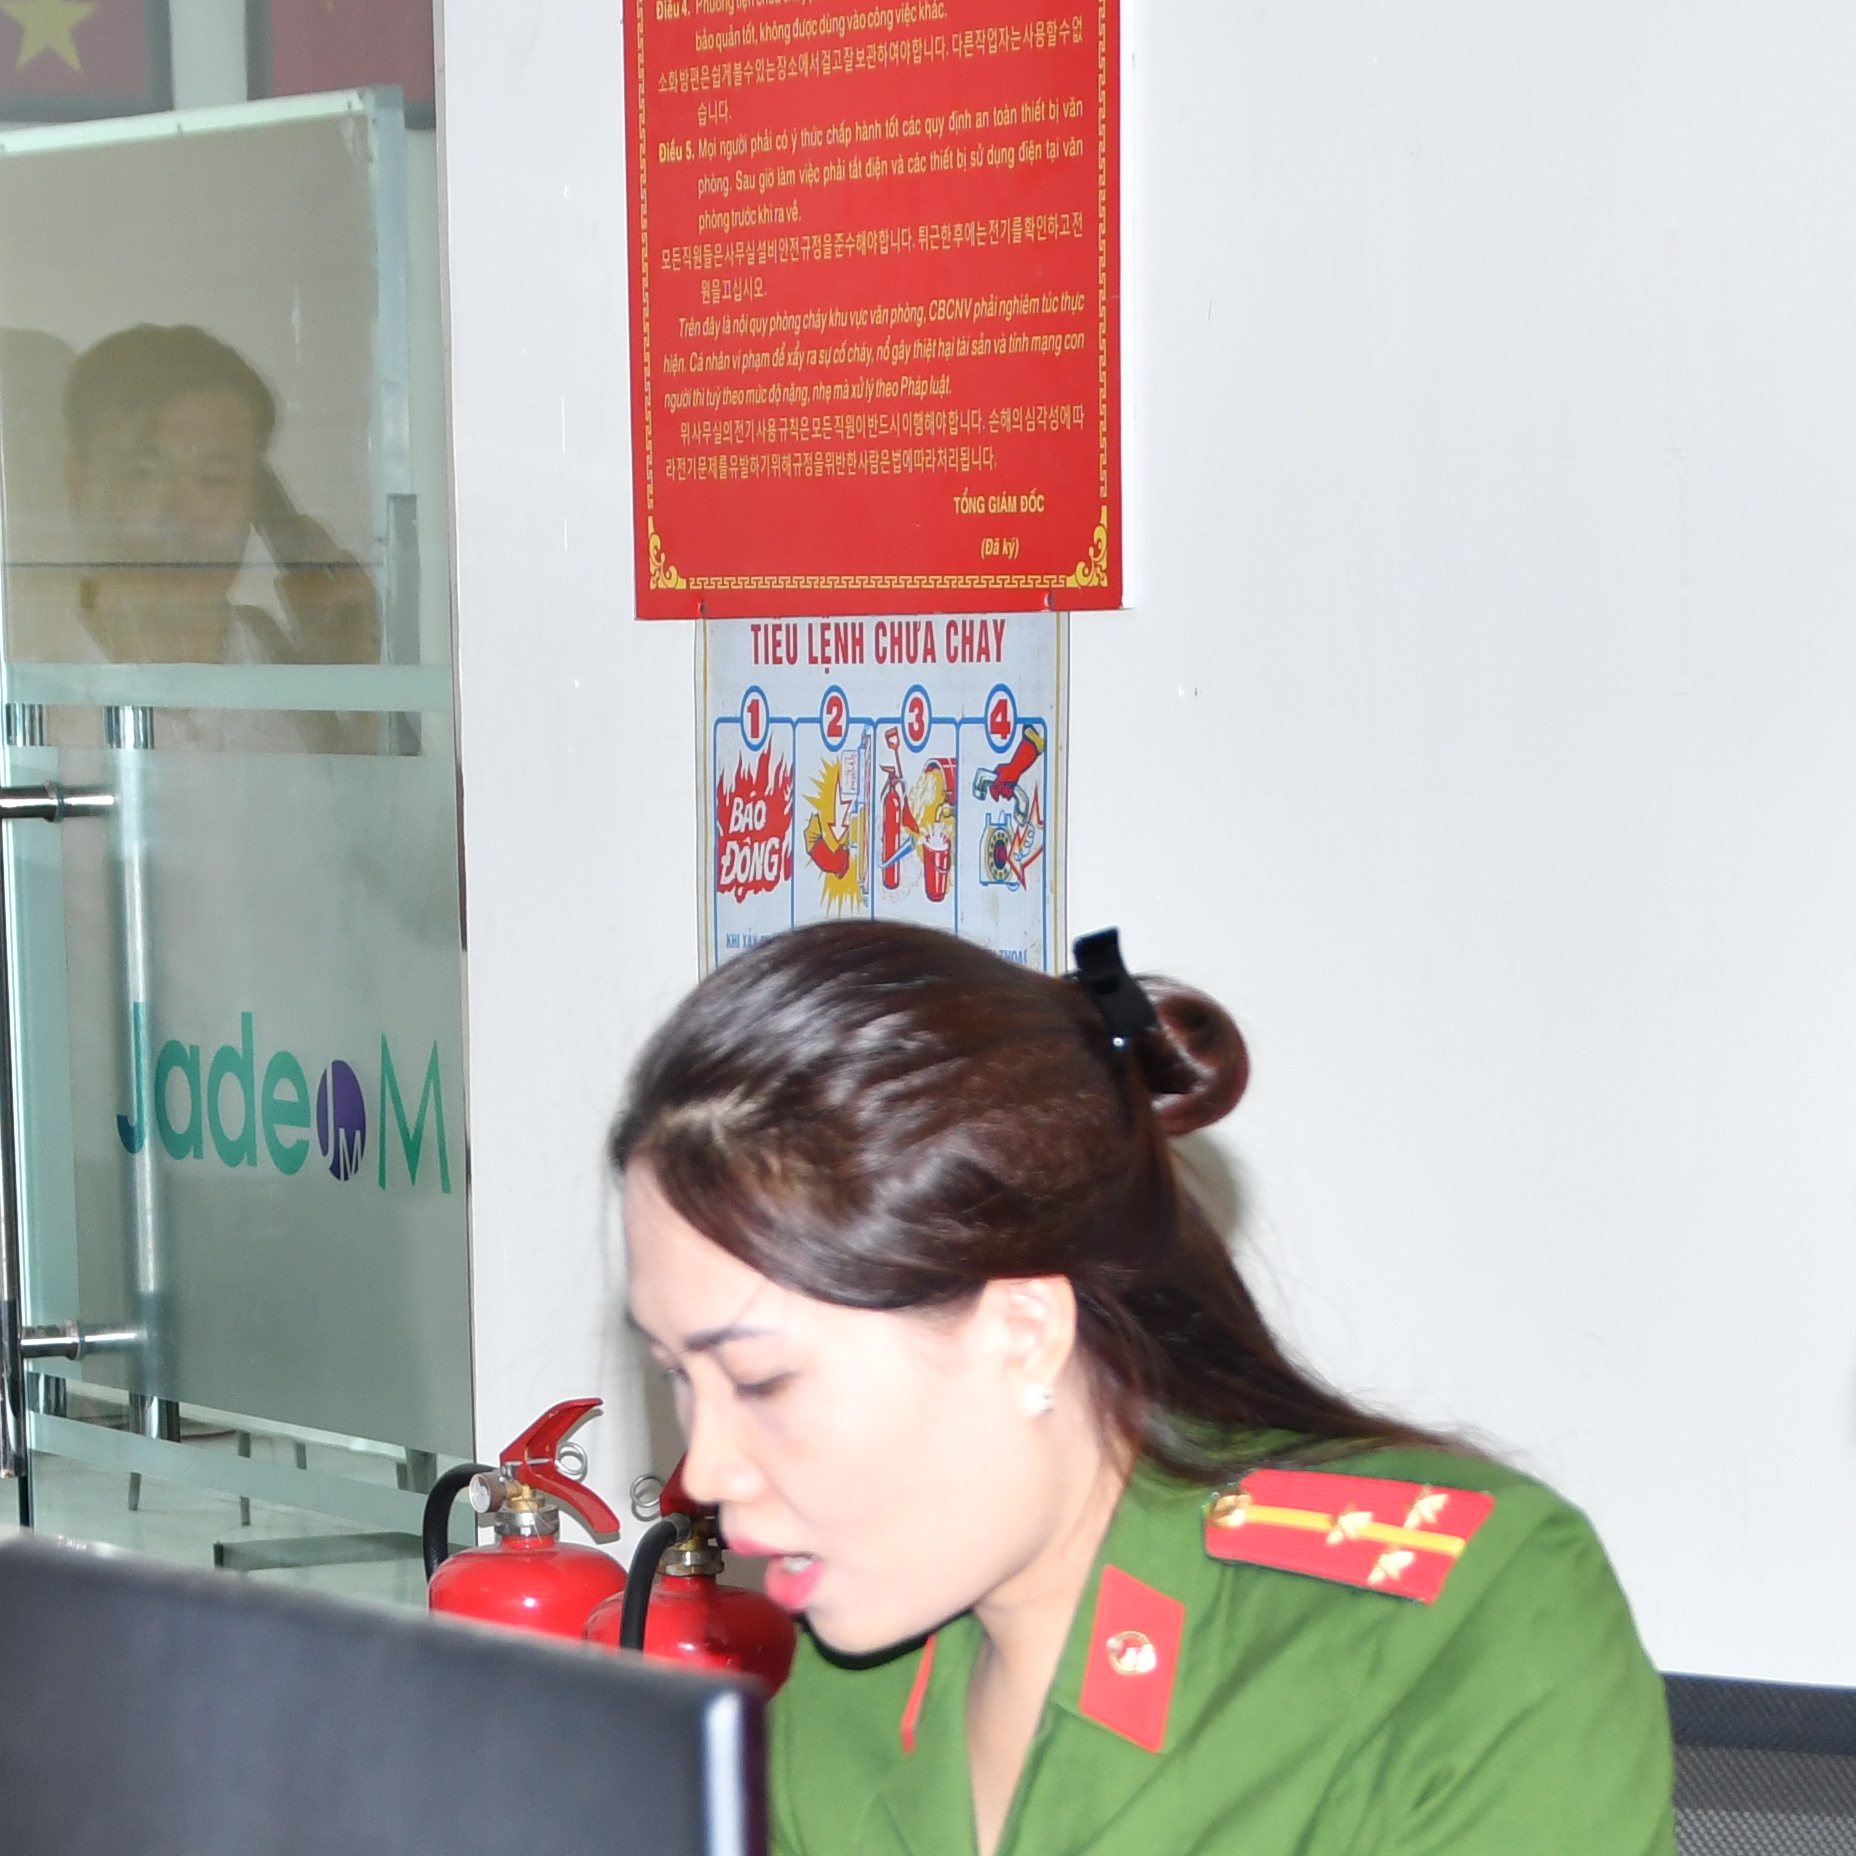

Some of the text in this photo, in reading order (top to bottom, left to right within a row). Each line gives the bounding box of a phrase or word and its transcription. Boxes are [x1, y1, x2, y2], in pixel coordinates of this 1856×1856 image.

[697, 99, 732, 127] 습니다.
[953, 487, 1045, 514] TỔNG GIÁM ĐỐC
[746, 696, 1011, 741] 1 2 3 4
[729, 791, 767, 834] BÁO
[720, 837, 781, 896] ĐỘNG
[117, 1002, 311, 1175] Jade
